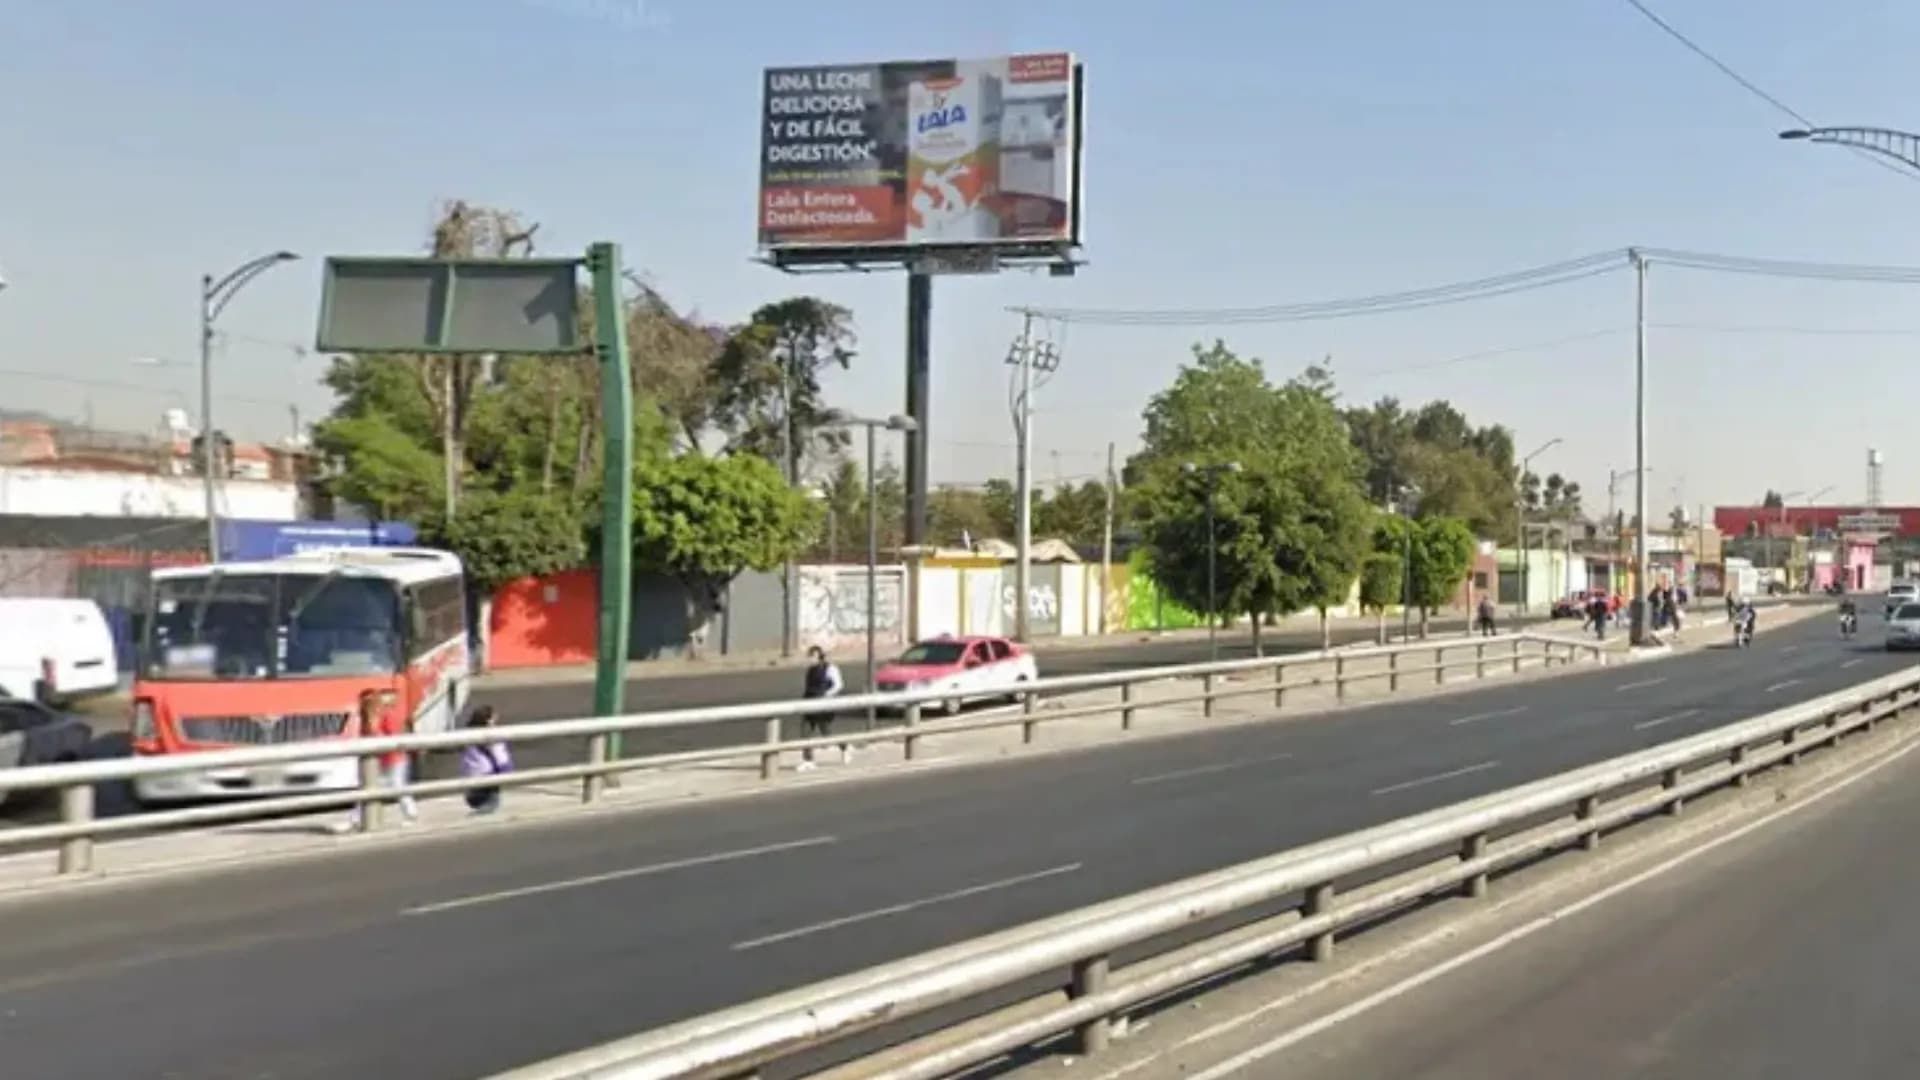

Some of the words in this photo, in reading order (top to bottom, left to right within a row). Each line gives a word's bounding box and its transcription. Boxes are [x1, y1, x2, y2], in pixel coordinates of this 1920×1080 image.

[771, 73, 812, 91] UNA
[816, 72, 871, 90] LECHE
[770, 95, 865, 114] DELICIOSA
[770, 121, 782, 138] Y
[786, 120, 811, 138] DE
[814, 114, 865, 137] FÁCIL
[918, 104, 966, 134] LALA
[767, 190, 800, 207] Lala
[804, 191, 856, 206] Entera
